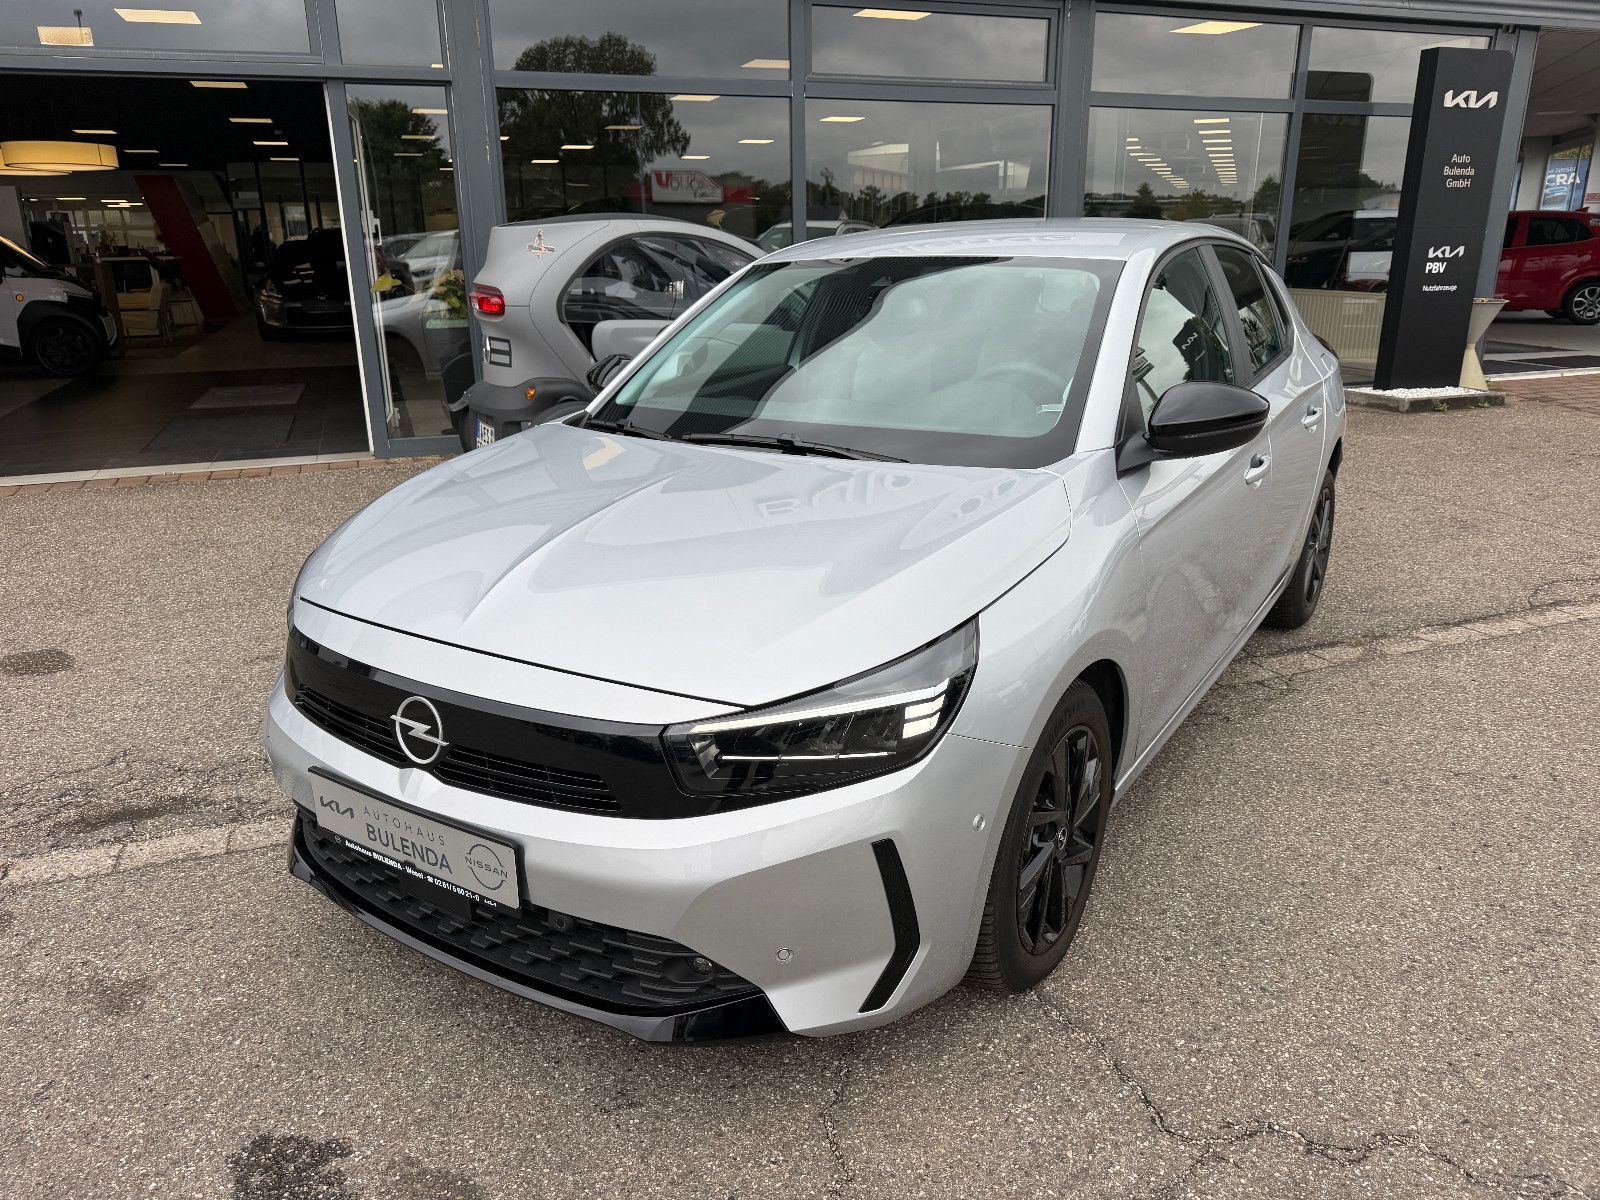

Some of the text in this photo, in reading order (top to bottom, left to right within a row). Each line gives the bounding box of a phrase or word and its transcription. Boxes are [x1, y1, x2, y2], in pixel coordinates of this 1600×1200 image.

[1443, 89, 1499, 109] KIA
[1451, 153, 1471, 163] Auto
[1443, 165, 1475, 176] Bulenda
[1446, 178, 1471, 188] GmbH
[1428, 245, 1465, 258] KIA
[1425, 261, 1447, 274] PBV
[1422, 284, 1458, 292] Nutzfahrzeuge
[363, 805, 446, 847] AUTOHAUS
[365, 822, 453, 875] BULENDA
[464, 855, 509, 879] NISSAN
